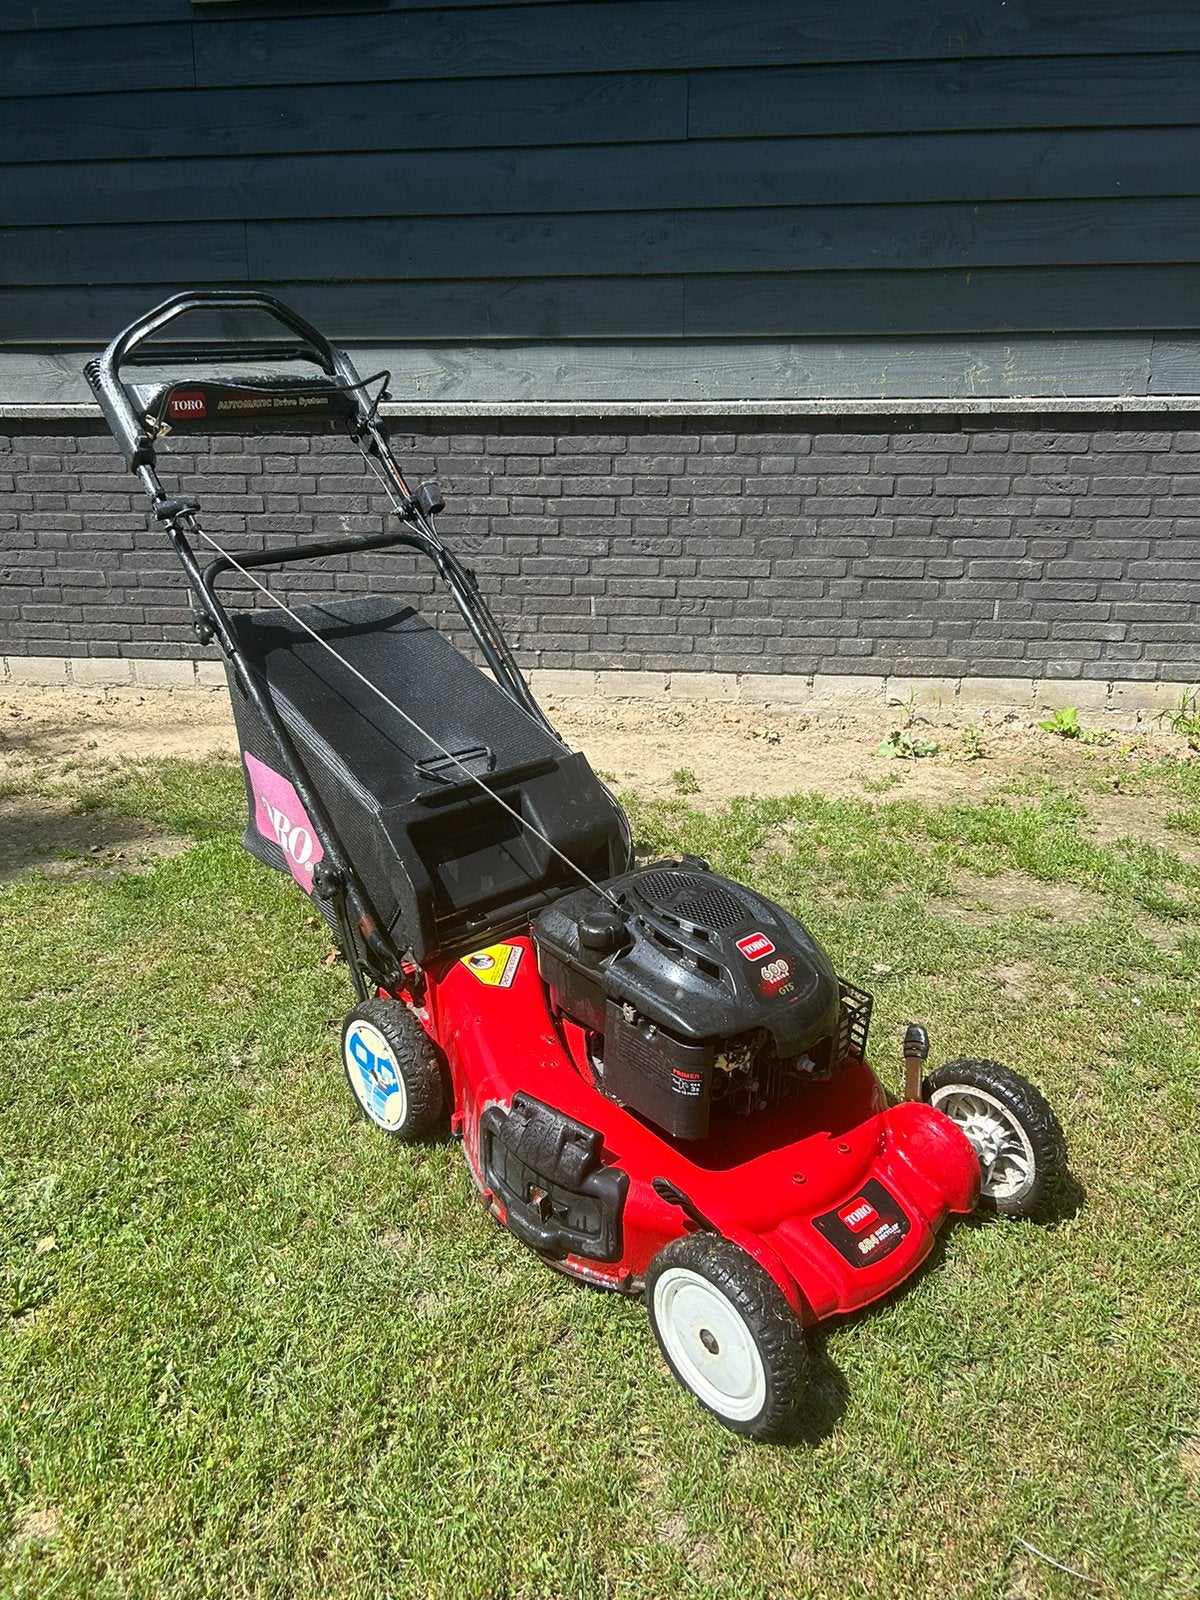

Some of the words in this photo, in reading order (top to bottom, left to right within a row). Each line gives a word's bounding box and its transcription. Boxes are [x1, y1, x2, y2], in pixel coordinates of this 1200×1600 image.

[171, 399, 204, 411] TORO
[217, 398, 272, 410] AUTOMATIC
[273, 398, 297, 407] Drive
[298, 397, 329, 407] System
[742, 938, 770, 955] TORO
[760, 959, 789, 981] 600
[779, 982, 795, 995] GTS
[672, 1067, 701, 1079] PRIMER
[844, 1204, 873, 1226] TORO
